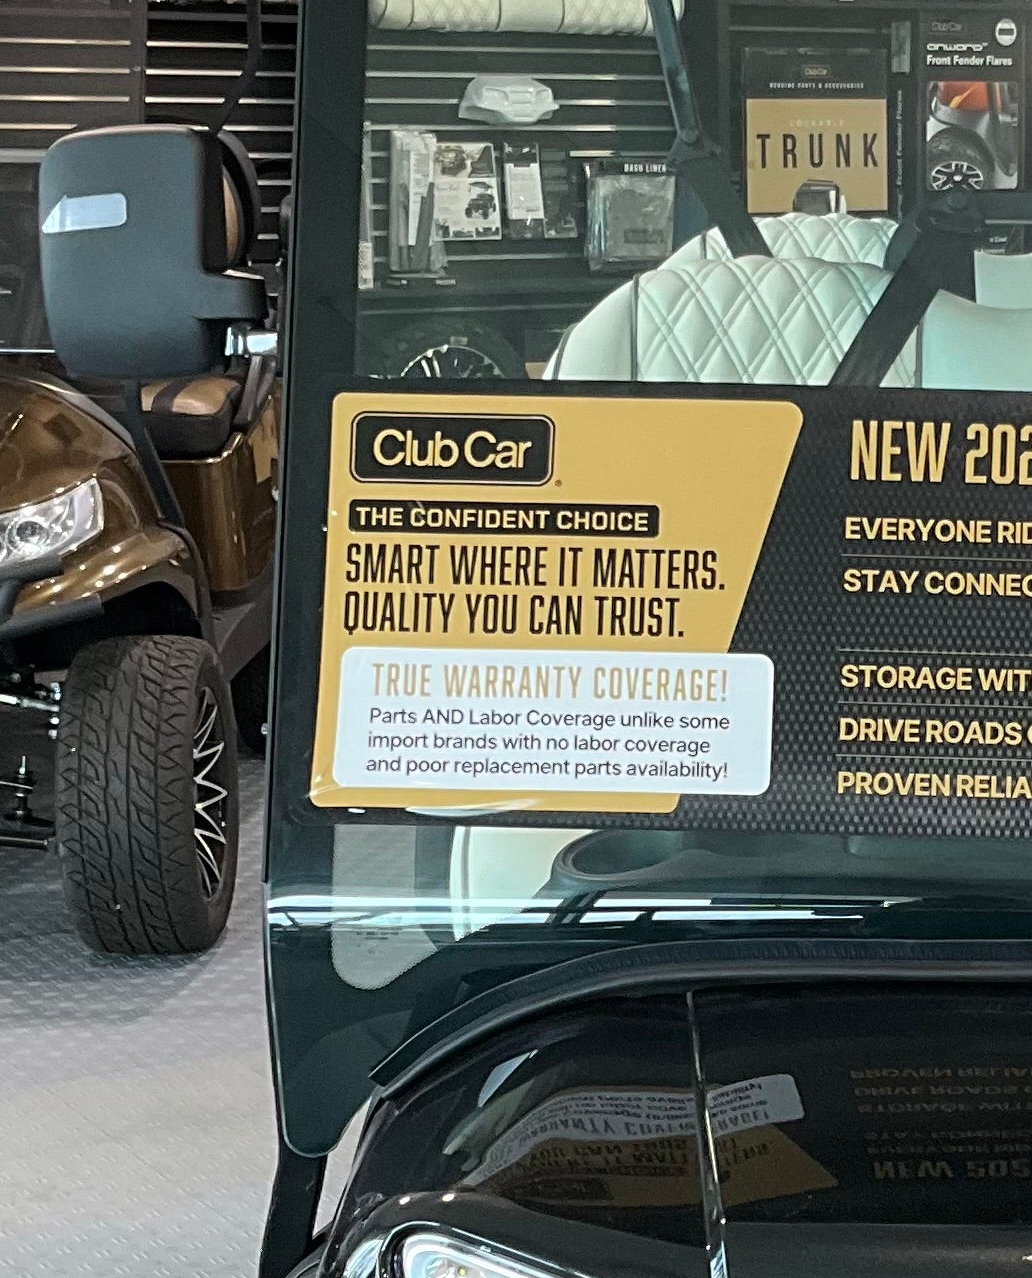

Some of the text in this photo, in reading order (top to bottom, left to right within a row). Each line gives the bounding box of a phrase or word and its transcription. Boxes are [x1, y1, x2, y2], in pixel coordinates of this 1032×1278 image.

[927, 55, 1012, 66] Front Fender Flares
[757, 134, 879, 168] TRUNK
[624, 163, 643, 172] DASH
[373, 429, 531, 468] Club Car
[851, 420, 950, 482] NEW
[356, 507, 649, 531] THE CONFIDENT CHOICE
[845, 517, 991, 543] EVERYONE
[346, 543, 725, 590] SMART WHERE IT MATTERS.
[844, 569, 919, 594] STAY
[344, 591, 684, 636] QUALITY YOU CAN TRUST.
[372, 663, 728, 701] TRUE WARRANTY COVERAGE!
[841, 664, 971, 690] STORAGE
[370, 708, 730, 730] Parts AND Labor Coverage unlike some
[839, 718, 921, 743] DRIVE
[926, 720, 1021, 745] ROADS
[368, 733, 710, 757] import brands with no labor coverage
[366, 757, 728, 782] and poor replacement parts availability!
[838, 772, 950, 797] PROVEN
